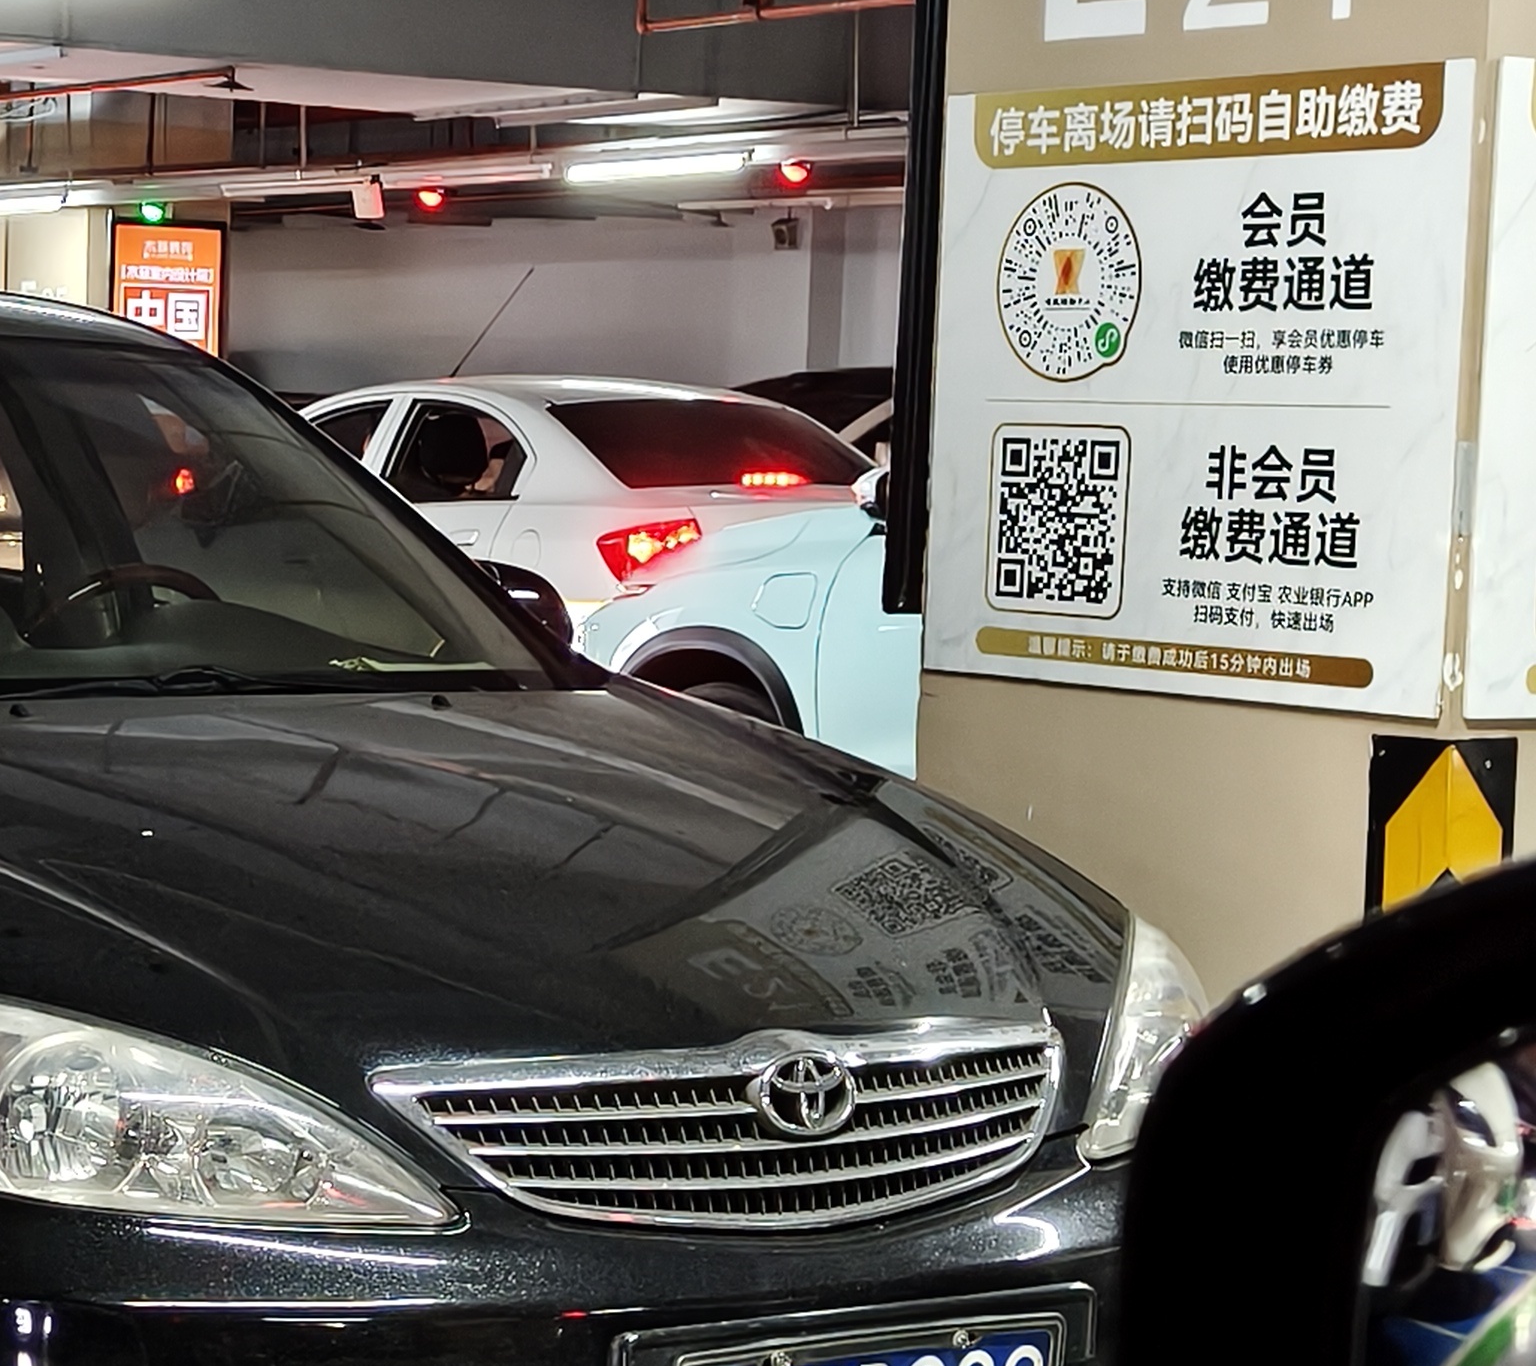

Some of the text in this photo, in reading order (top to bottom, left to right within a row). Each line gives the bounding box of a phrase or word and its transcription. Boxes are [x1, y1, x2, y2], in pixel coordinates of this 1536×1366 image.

[990, 80, 1423, 157] 停车离场请扫码自助缴费
[1241, 191, 1327, 248] 会员
[1193, 253, 1374, 312] 缴费通道
[1223, 354, 1333, 374] 使用优惠停车券
[1205, 444, 1337, 504] 非会员
[1179, 506, 1360, 569] 缴费通道
[1162, 578, 1222, 600] 支持微信
[1226, 582, 1273, 603] 支付宝
[1193, 604, 1335, 633] 扫码支付，快速出场
